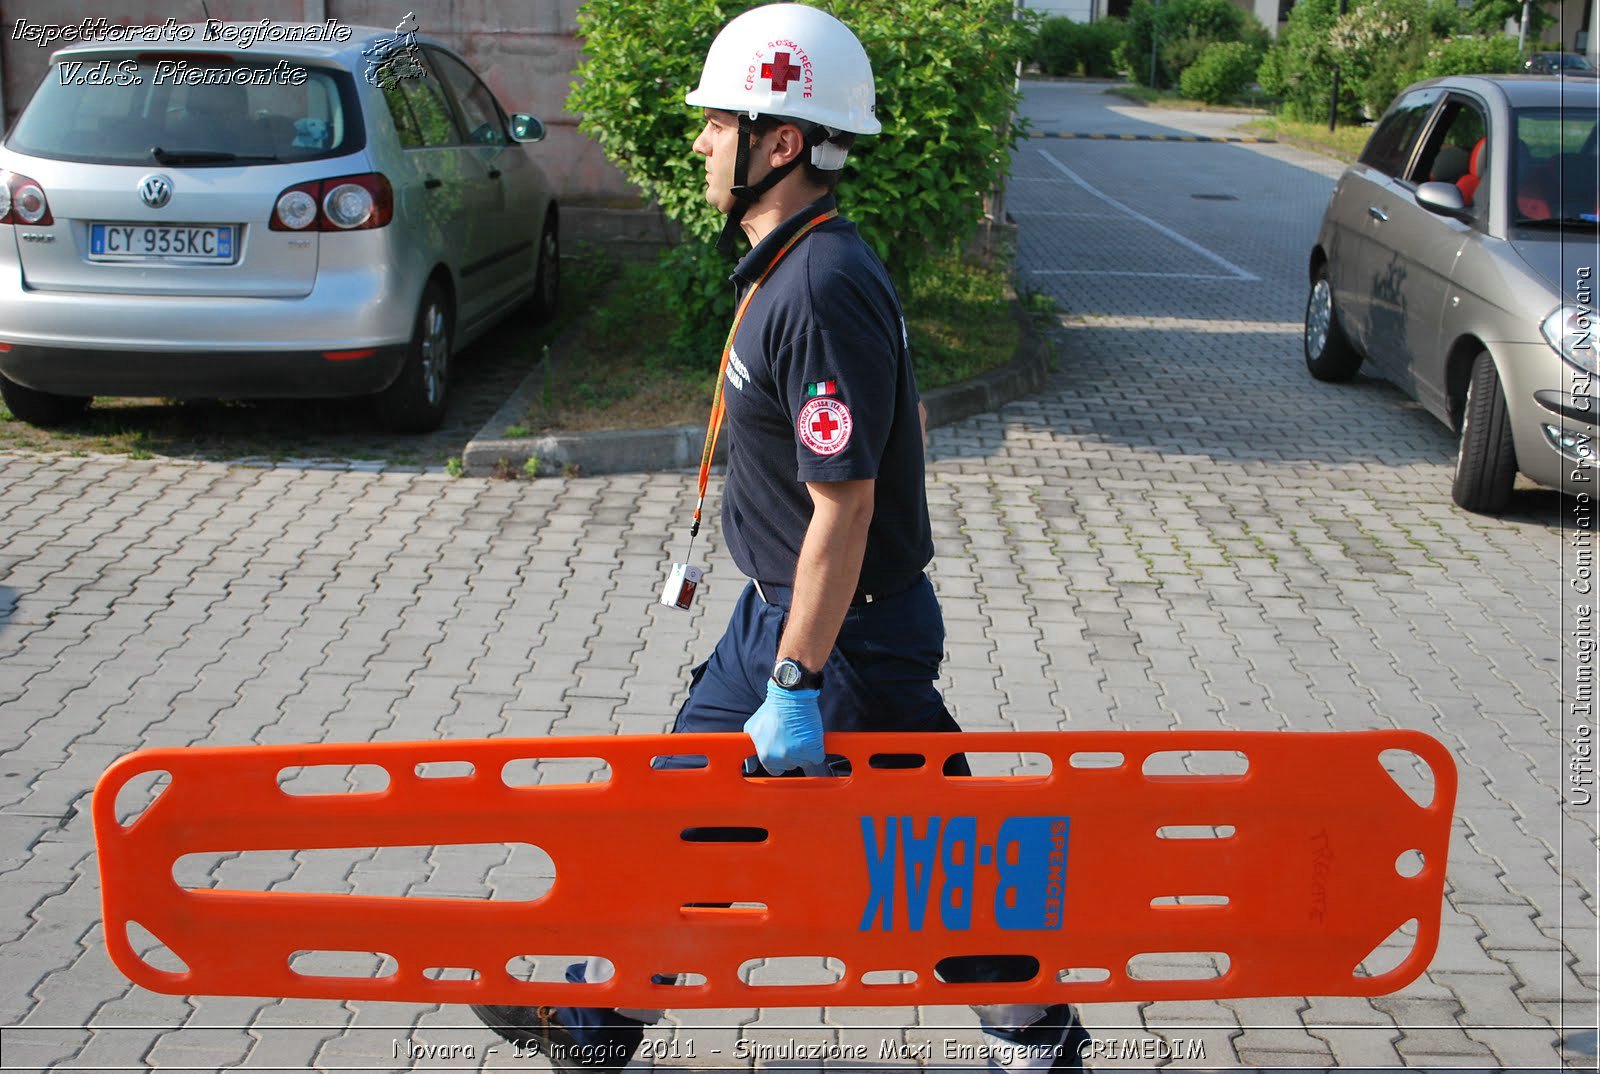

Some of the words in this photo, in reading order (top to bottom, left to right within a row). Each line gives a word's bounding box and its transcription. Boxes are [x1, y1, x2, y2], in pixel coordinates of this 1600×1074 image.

[107, 227, 136, 252] CY
[143, 229, 216, 255] 935KC
[858, 816, 1069, 931] B-BAK
[1043, 820, 1067, 928] SPENCER
